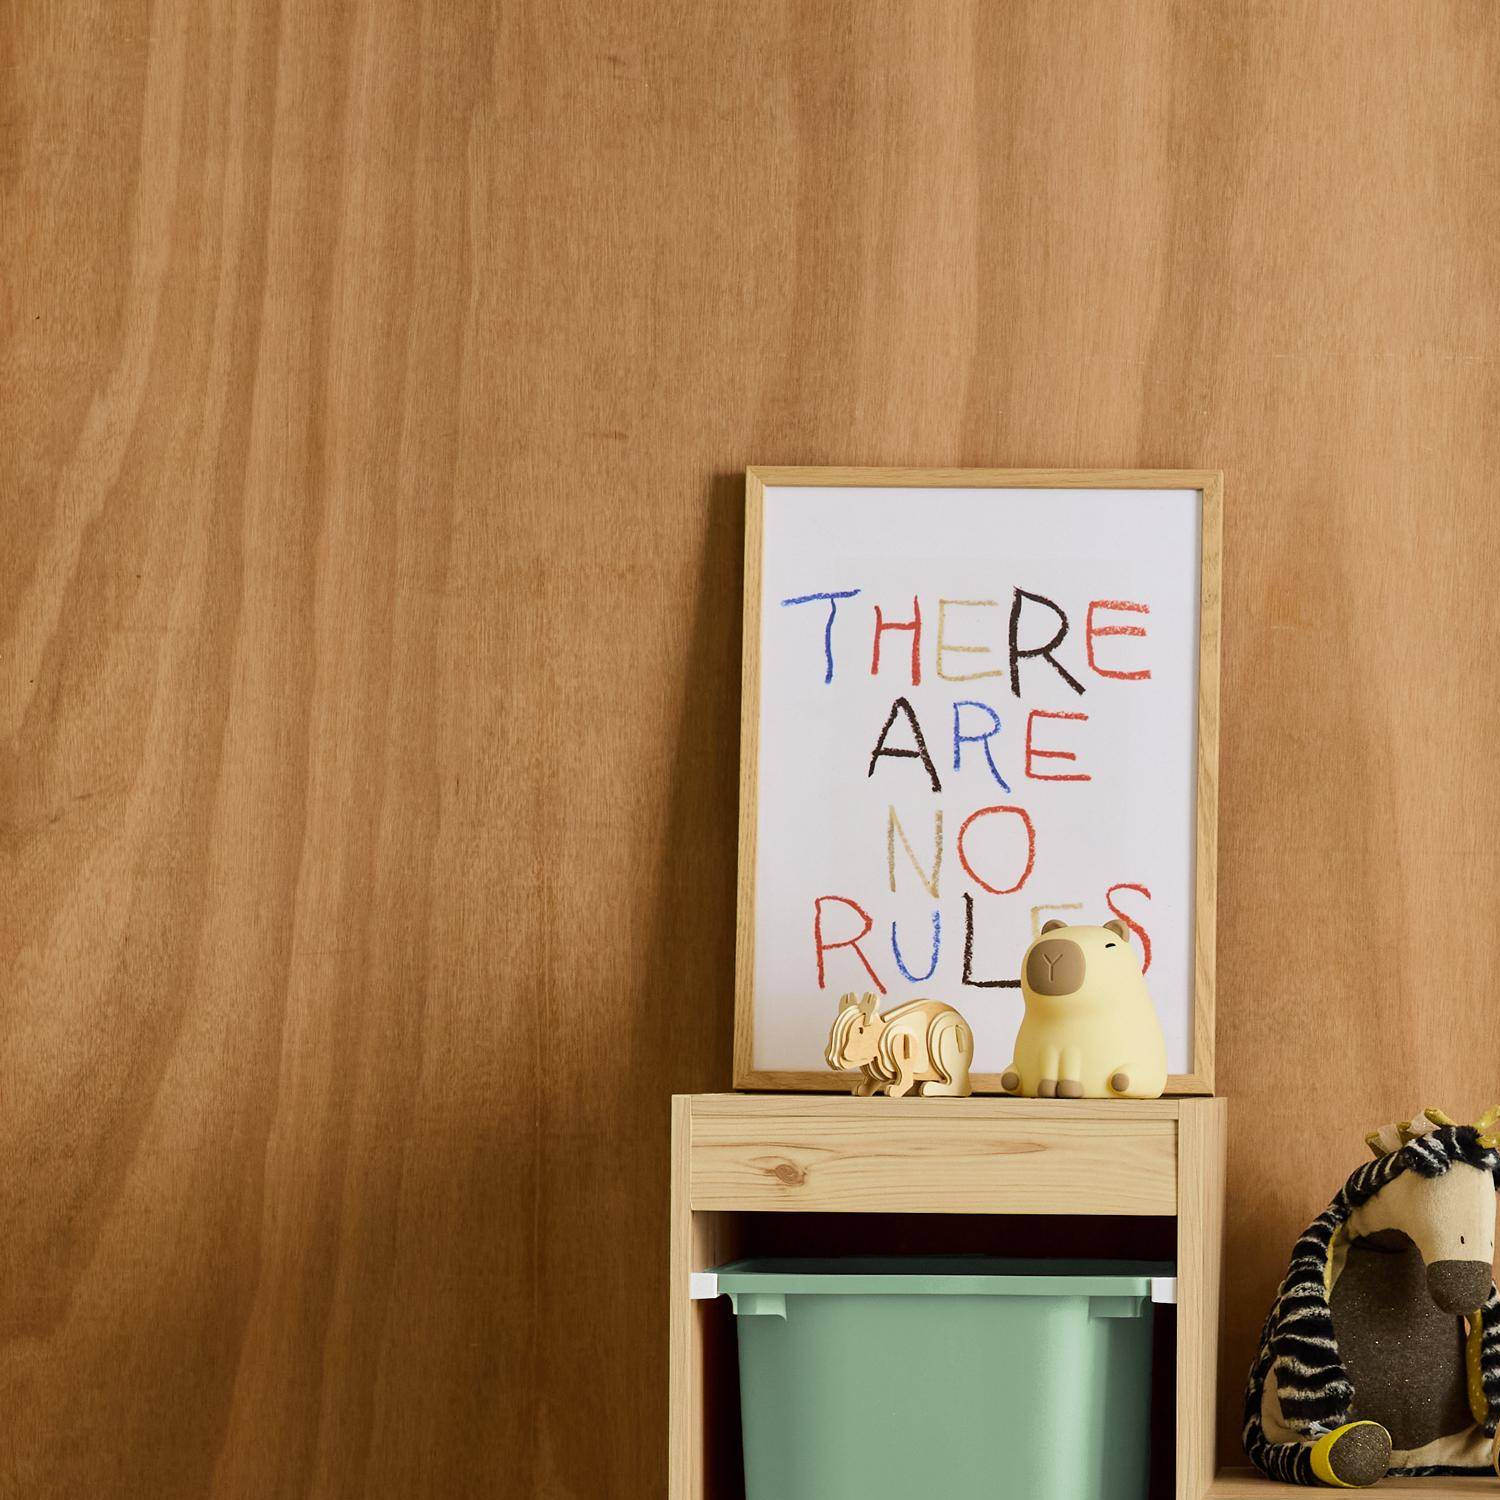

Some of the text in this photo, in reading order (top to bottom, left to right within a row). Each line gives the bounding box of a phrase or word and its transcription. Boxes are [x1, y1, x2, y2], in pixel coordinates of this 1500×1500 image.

[781, 587, 1152, 697] THERE
[868, 697, 1092, 793] ARE
[888, 805, 1036, 899] NO
